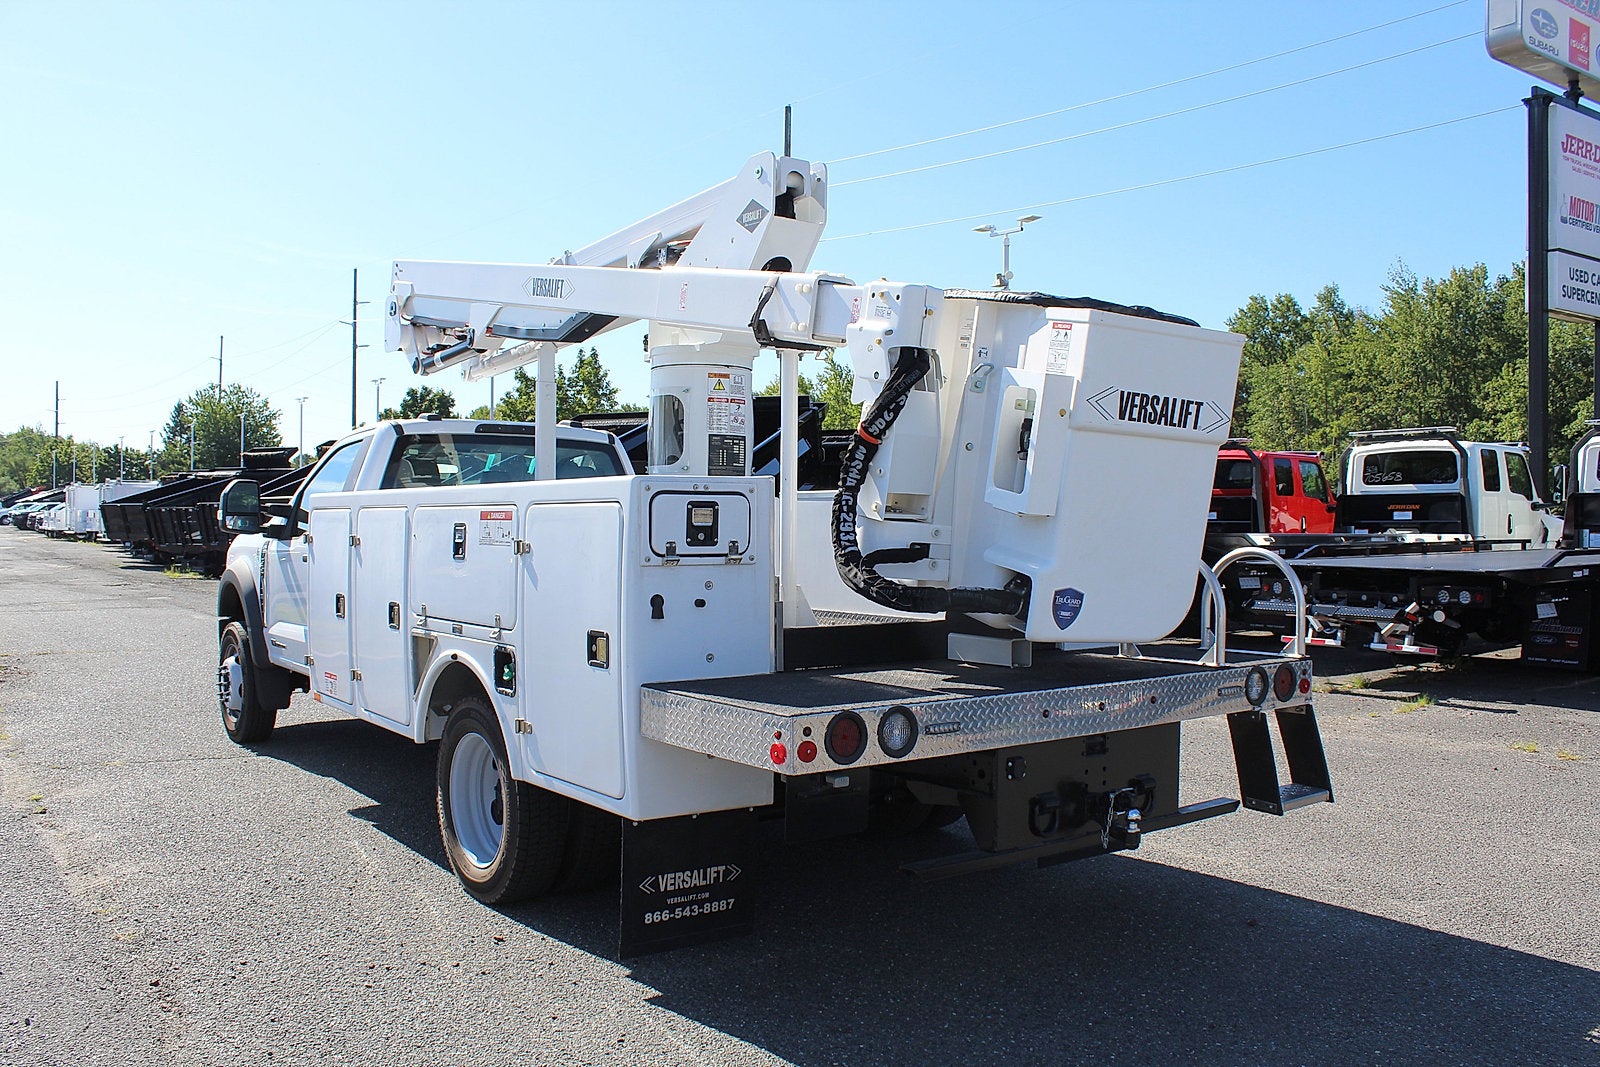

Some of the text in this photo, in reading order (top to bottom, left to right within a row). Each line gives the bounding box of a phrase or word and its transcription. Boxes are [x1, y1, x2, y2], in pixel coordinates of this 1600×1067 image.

[1528, 35, 1559, 56] SUBARU
[1569, 216, 1592, 231] CERTIFIED
[1569, 267, 1589, 284] USED
[532, 277, 564, 298] VERSALIFT
[1118, 390, 1203, 430] VERSALIFT
[658, 865, 726, 892] VERSALIFT
[666, 892, 710, 905] VERSALIFT.COM
[644, 898, 735, 924] 866-543-8887
